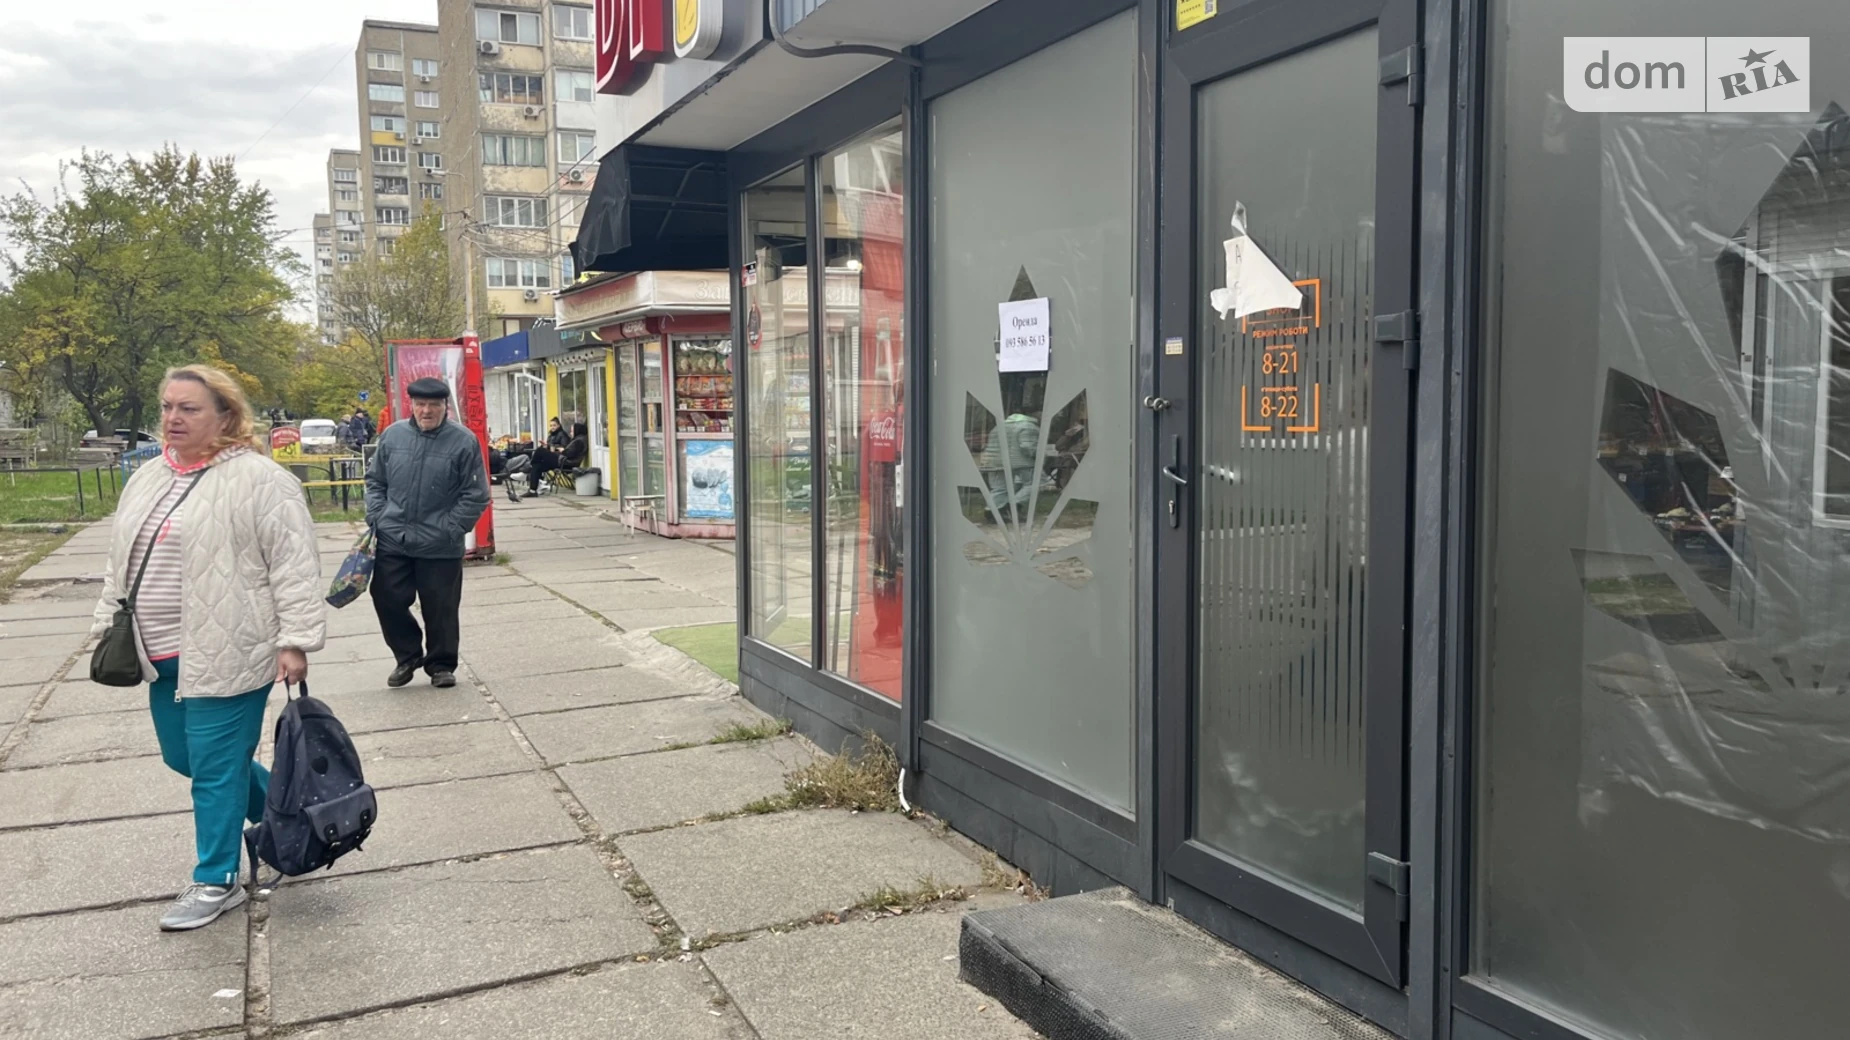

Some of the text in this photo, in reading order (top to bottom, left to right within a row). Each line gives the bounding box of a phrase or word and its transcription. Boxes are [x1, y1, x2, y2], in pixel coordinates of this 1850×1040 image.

[1252, 326, 1308, 338] РЕЖИМ РОБОТИ
[1262, 351, 1298, 375] 8-21
[1260, 395, 1298, 418] 8-22
